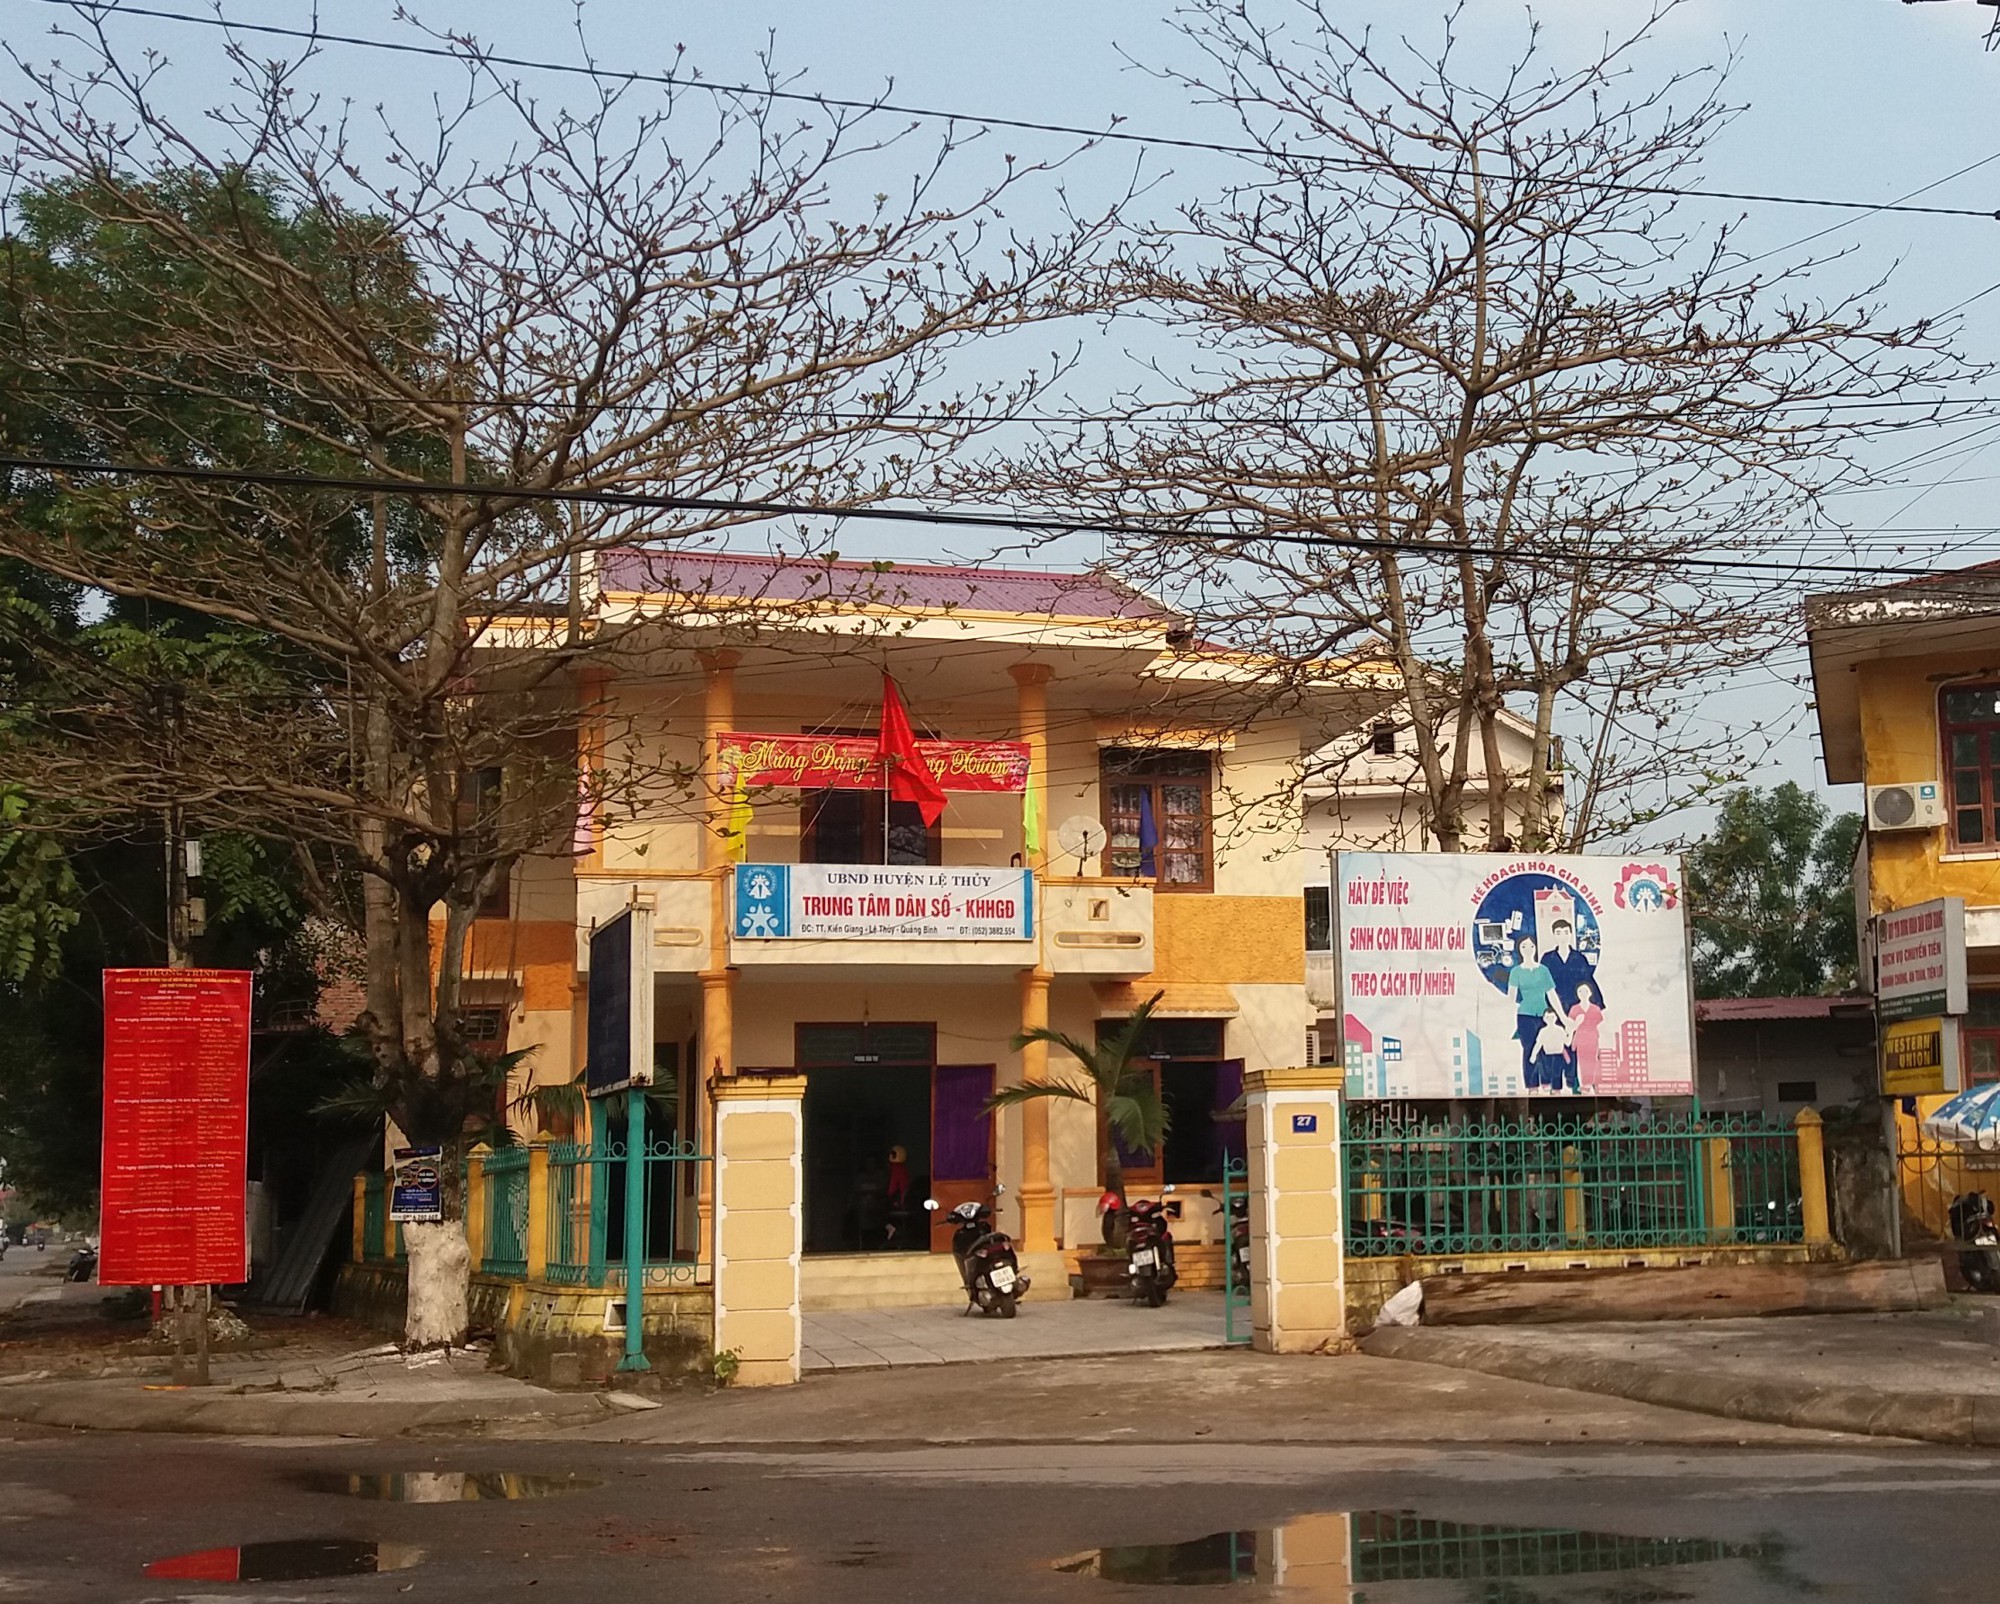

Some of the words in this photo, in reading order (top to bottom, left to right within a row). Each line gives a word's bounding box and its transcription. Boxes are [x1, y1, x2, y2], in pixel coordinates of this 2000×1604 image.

[742, 739, 810, 781] Mừng
[811, 741, 871, 784] Đảng
[949, 748, 1010, 777] Xuân
[827, 872, 869, 885] UBND
[873, 873, 925, 888] HUYỆN
[929, 874, 948, 889] LỆ
[951, 872, 992, 888] THỦY
[1558, 869, 1580, 887] GIA
[1371, 868, 1386, 905] ĐỂ
[1387, 876, 1409, 912] VIỆC
[802, 895, 853, 917] TRUNG
[858, 892, 891, 918] TÂM
[895, 894, 927, 918] DÂN
[931, 892, 953, 919] SỐ
[966, 898, 1016, 920] KHHGĐ
[801, 924, 814, 933] ĐC:
[828, 924, 843, 933] Kiến
[844, 924, 864, 936] Giang
[900, 925, 922, 936] Quảng
[972, 926, 988, 936] (052)
[1349, 927, 1375, 951] SINH
[1376, 927, 1399, 951] CON
[1401, 927, 1423, 950] TRAI
[1425, 927, 1446, 950] HAY
[1447, 920, 1466, 950] GÁI
[1351, 973, 1378, 997] THEO
[1380, 966, 1407, 997] CÁCH
[1409, 968, 1423, 1003] TỰ
[1424, 966, 1456, 996] NHIÊN
[1886, 1033, 1931, 1054] WESTERN
[1899, 1050, 1931, 1069] UNION
[1296, 1116, 1312, 1126] 27
